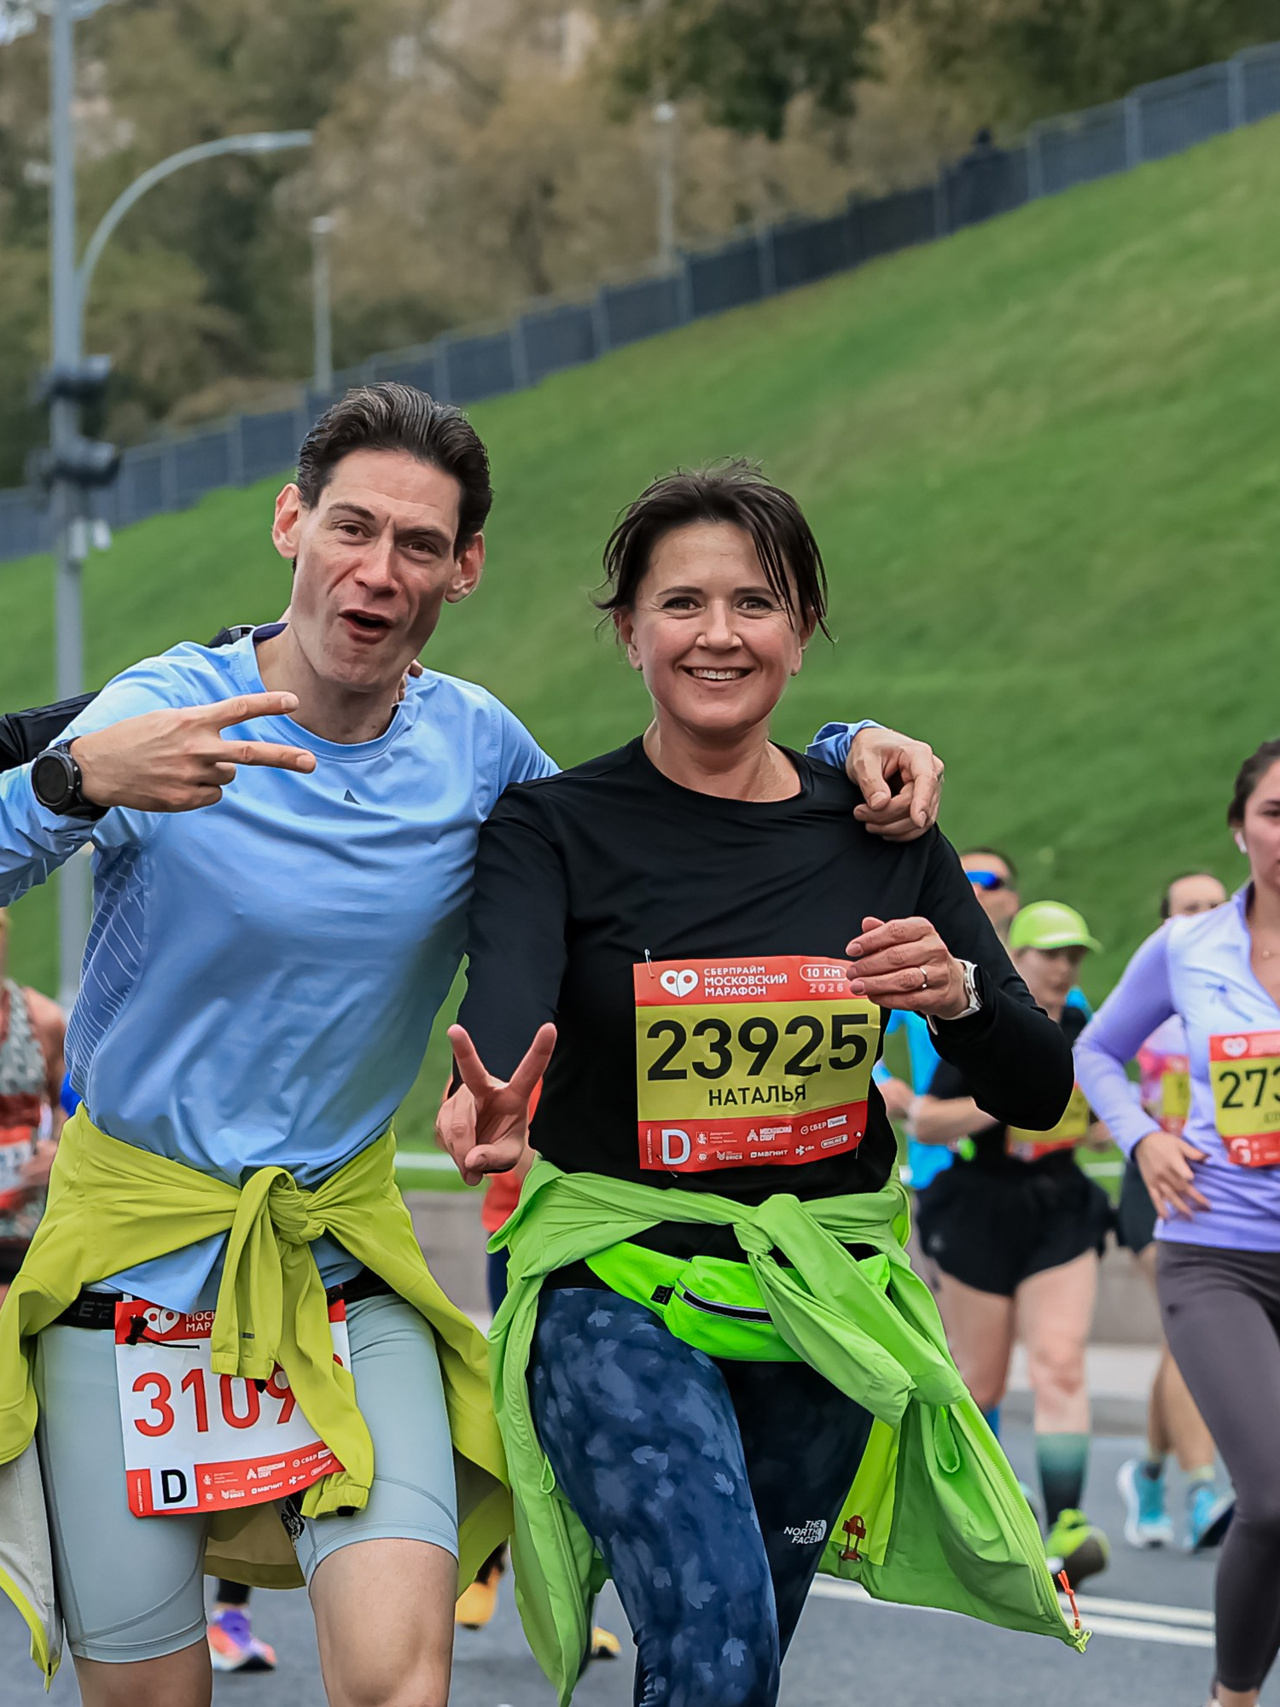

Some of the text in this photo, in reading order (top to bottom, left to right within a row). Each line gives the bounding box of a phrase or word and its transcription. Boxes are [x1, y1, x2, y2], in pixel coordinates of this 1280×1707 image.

[704, 965, 765, 975] СБЕРПРАЙМ
[806, 968, 841, 978] 10 КМ
[704, 973, 788, 986] МОСКОВСКИЙ
[704, 986, 766, 997] МАРАФОН
[809, 983, 844, 994] 2026
[646, 1013, 869, 1081] 23925
[708, 1084, 806, 1107] НАТАЛЬЯ
[662, 1129, 691, 1165] D
[160, 1469, 187, 1504] D
[805, 1520, 821, 1529] THE
[783, 1526, 820, 1536] NORTH
[791, 1535, 816, 1544] FACE
